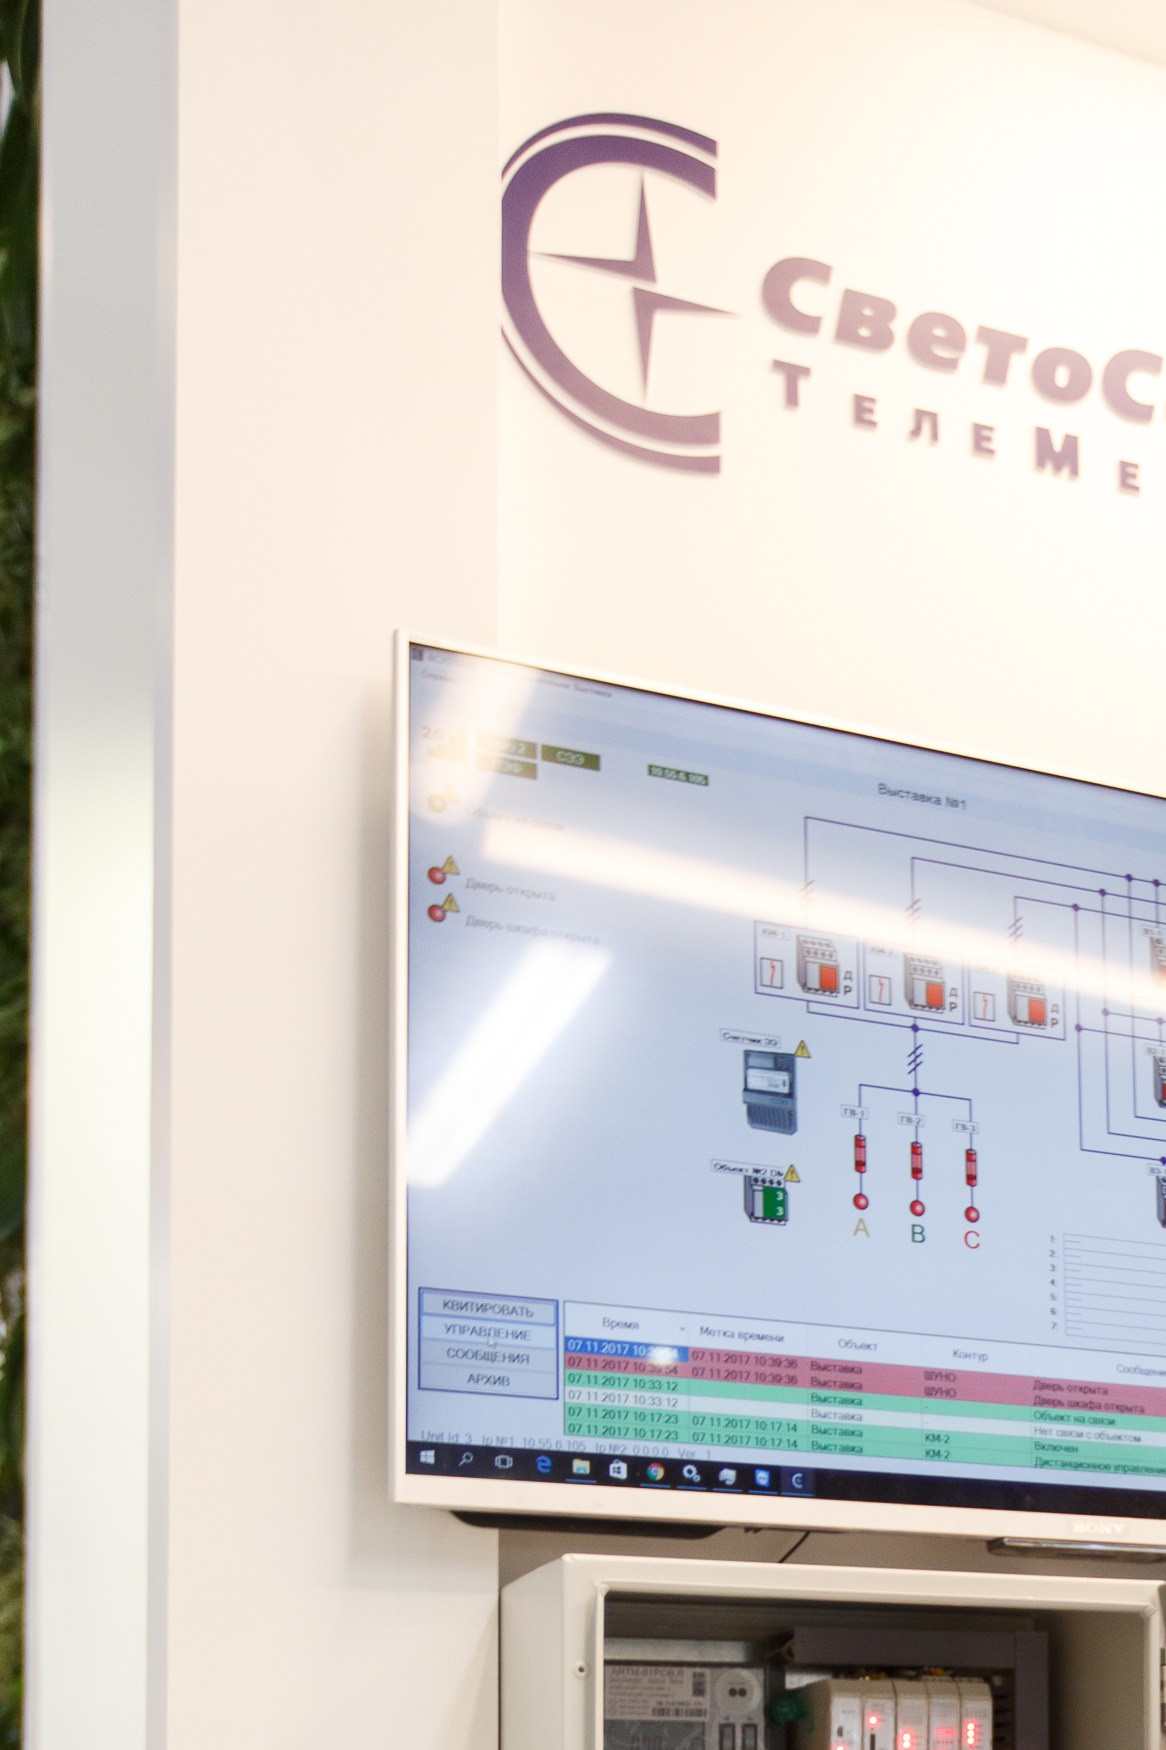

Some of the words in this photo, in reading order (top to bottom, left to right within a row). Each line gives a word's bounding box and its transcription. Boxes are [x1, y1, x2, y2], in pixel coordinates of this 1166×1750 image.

[877, 783, 943, 808] Выставка
[505, 886, 556, 901] открыта
[443, 1300, 534, 1318] КВИТИРОВАТЬ
[602, 1317, 640, 1331] Время
[443, 1324, 531, 1341] УПРАВЛЕНИЕ
[699, 1326, 735, 1338] Метка
[737, 1331, 785, 1345] времени
[838, 1338, 877, 1351] Объект
[446, 1347, 530, 1365] СООБЩЕНИЯ
[568, 1356, 629, 1369] 07.11.2017
[952, 1349, 989, 1363] Контур
[810, 1360, 863, 1375] Выставка
[467, 1373, 511, 1387] АРХИВ
[568, 1373, 629, 1387] 07.11.2017
[810, 1377, 863, 1390] Выставка
[924, 1372, 956, 1382] ШУНО
[924, 1387, 956, 1398] ШУНО
[1033, 1380, 1064, 1393] Дверь
[1066, 1385, 1108, 1396] открыта
[568, 1390, 629, 1404] 07.11.2017
[811, 1393, 863, 1406] Выставка
[1033, 1396, 1064, 1408] Дверь
[1067, 1400, 1102, 1412] шкафа
[1103, 1403, 1145, 1414] открыта
[568, 1407, 629, 1420] 07.11.2017
[811, 1408, 863, 1422] Выставка
[1034, 1410, 1071, 1423] Объект
[1074, 1415, 1085, 1423] на
[1088, 1416, 1116, 1426] связи
[568, 1423, 629, 1436] 07.11.2017
[811, 1424, 863, 1438] Выставка
[1034, 1426, 1053, 1435] Нет
[1055, 1429, 1084, 1439] связи
[1094, 1431, 1142, 1444] объектом
[925, 1433, 950, 1444] КМ-2
[811, 1440, 864, 1454] Выставка
[1034, 1441, 1079, 1454] Включен
[925, 1449, 950, 1460] КМ-2
[1035, 1456, 1111, 1472] Дистанционное
